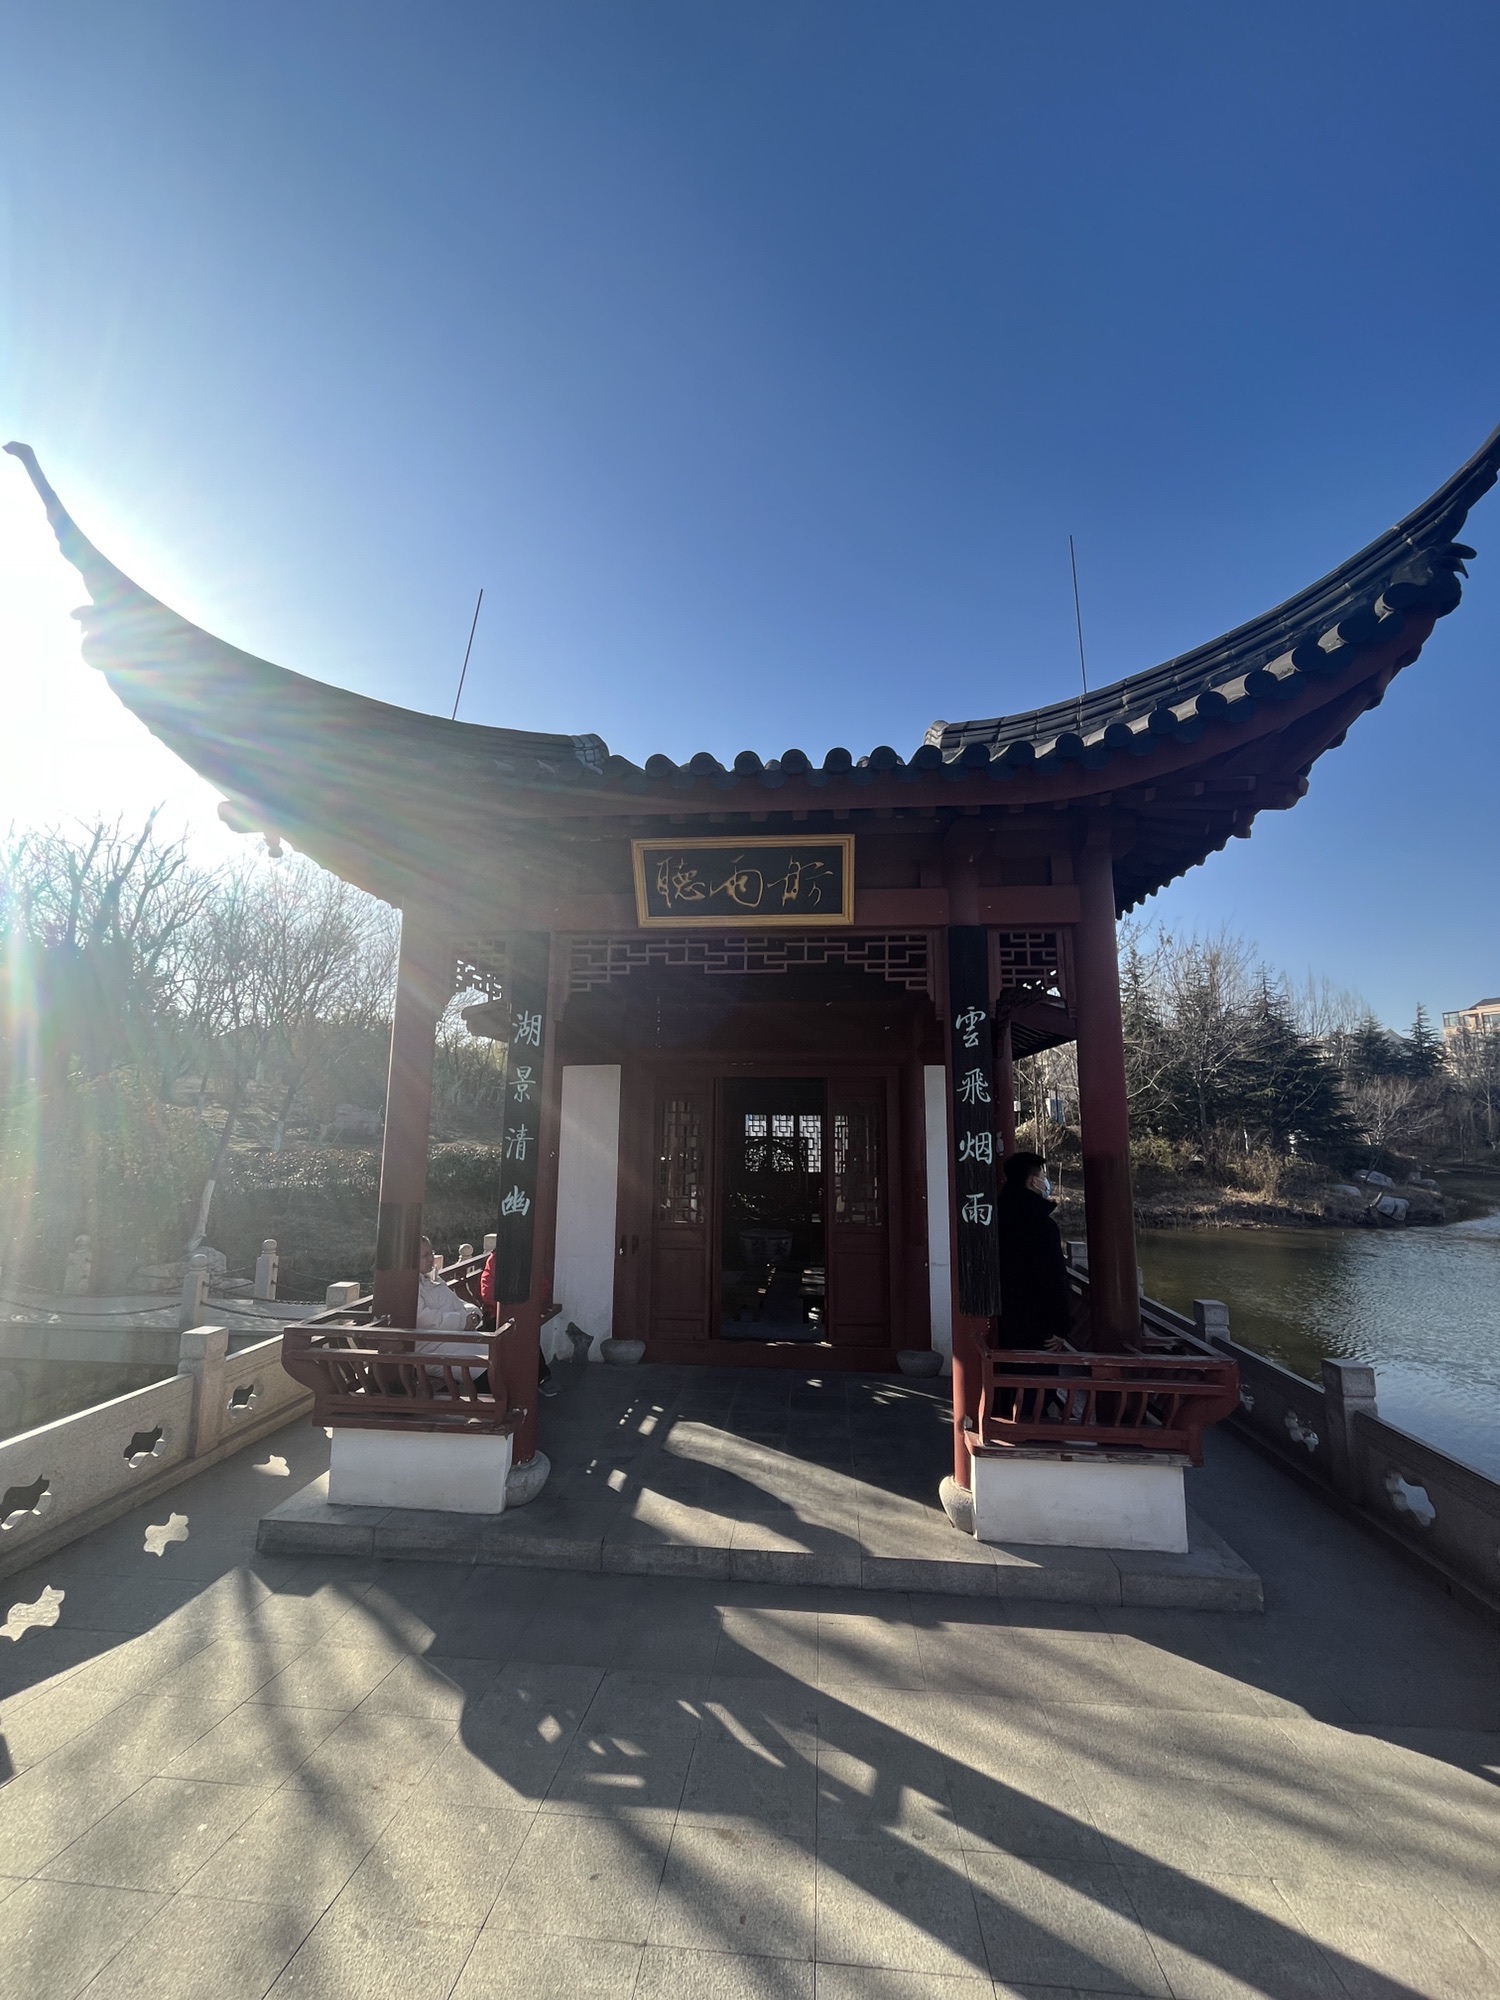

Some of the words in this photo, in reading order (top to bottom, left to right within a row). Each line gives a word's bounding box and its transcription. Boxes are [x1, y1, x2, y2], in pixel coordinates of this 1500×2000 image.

[501, 1009, 543, 1217] 湖景清幽
[955, 1006, 993, 1226] 雲飛烟雨
